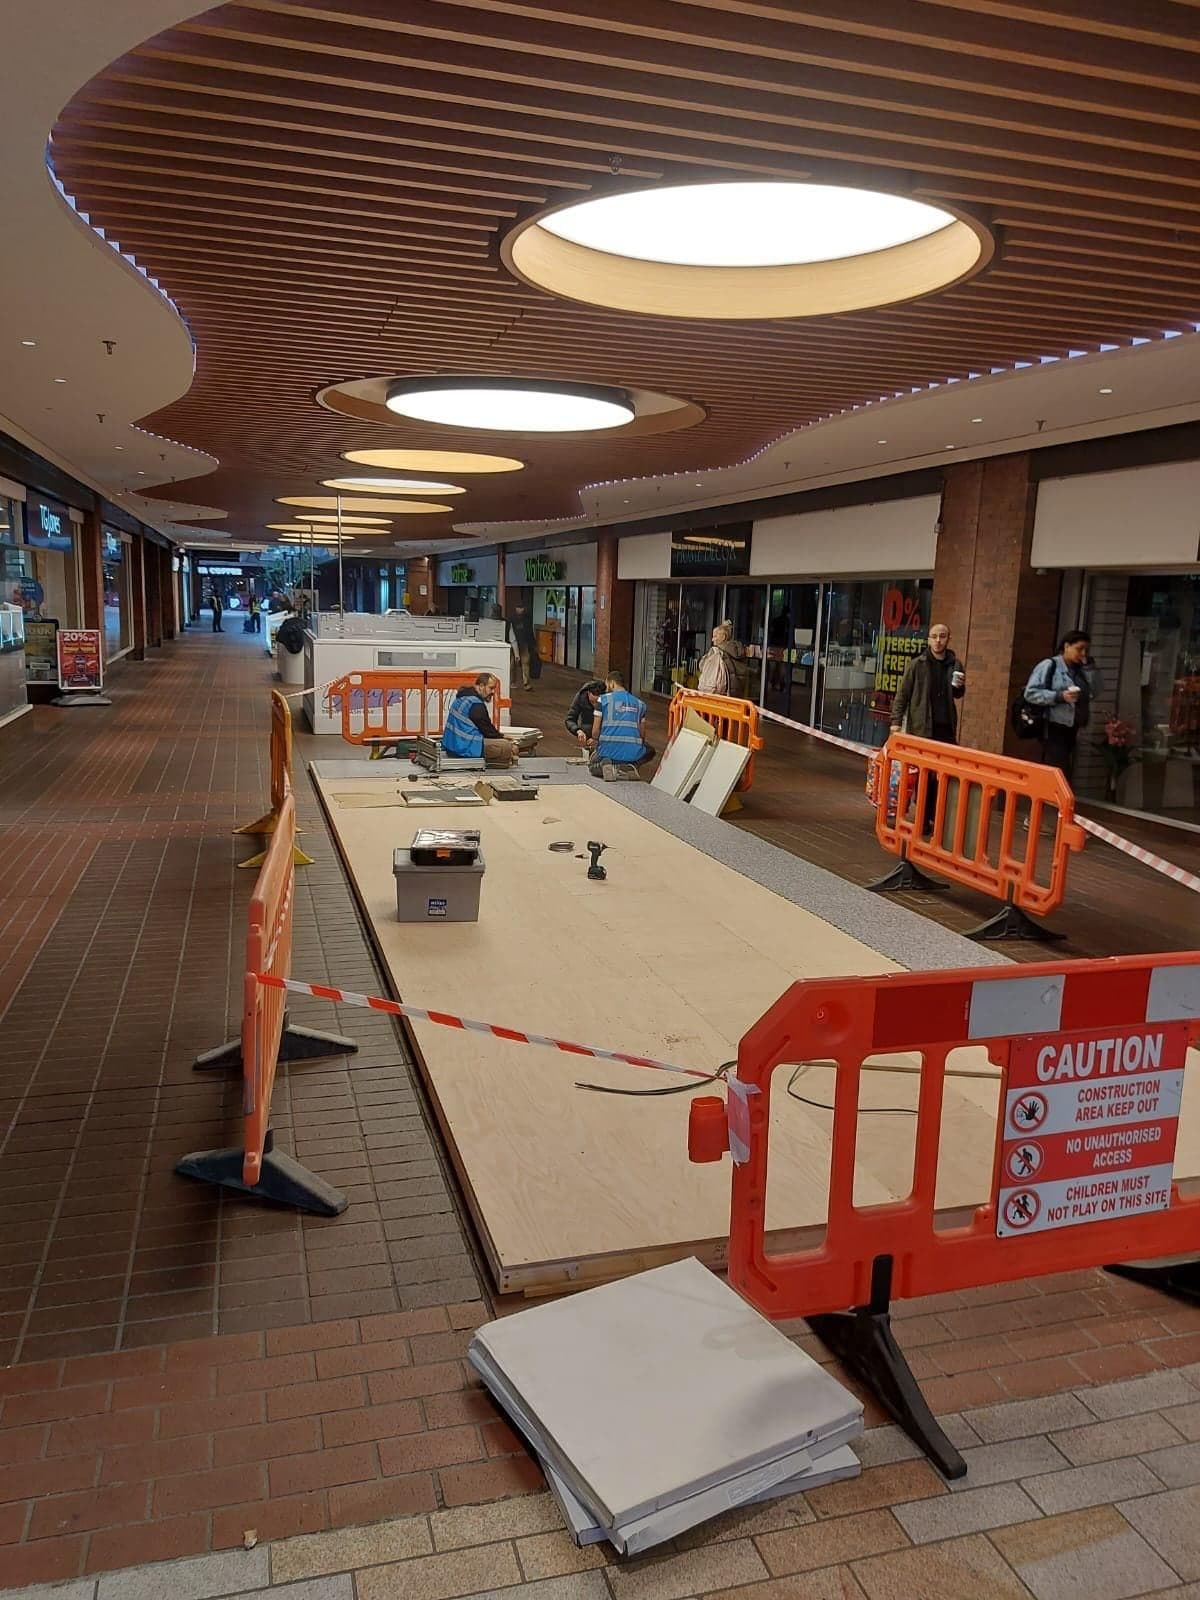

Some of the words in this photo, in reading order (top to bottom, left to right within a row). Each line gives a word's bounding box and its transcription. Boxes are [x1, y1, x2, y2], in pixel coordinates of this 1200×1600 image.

[525, 556, 557, 582] Waitrose
[63, 632, 89, 642] 20%
[876, 635, 926, 654] INTEREST
[1036, 1033, 1163, 1082] CAUTION
[1077, 1080, 1161, 1103] CONSTRUCTION
[1075, 1107, 1104, 1122] AREA
[1107, 1101, 1134, 1118] KEEP
[1137, 1098, 1159, 1113] OUT
[1066, 1138, 1082, 1154] NO
[1084, 1127, 1161, 1149] UNAUTHORISED
[1093, 1149, 1132, 1168] ACCESS
[1066, 1179, 1118, 1201] CHILDREN
[1121, 1175, 1150, 1192] MUST
[1047, 1206, 1069, 1222] NOT
[1072, 1202, 1098, 1218] PLAY
[1101, 1198, 1116, 1213] ON
[1118, 1194, 1142, 1210] THIS
[1145, 1190, 1167, 1206] SITE
